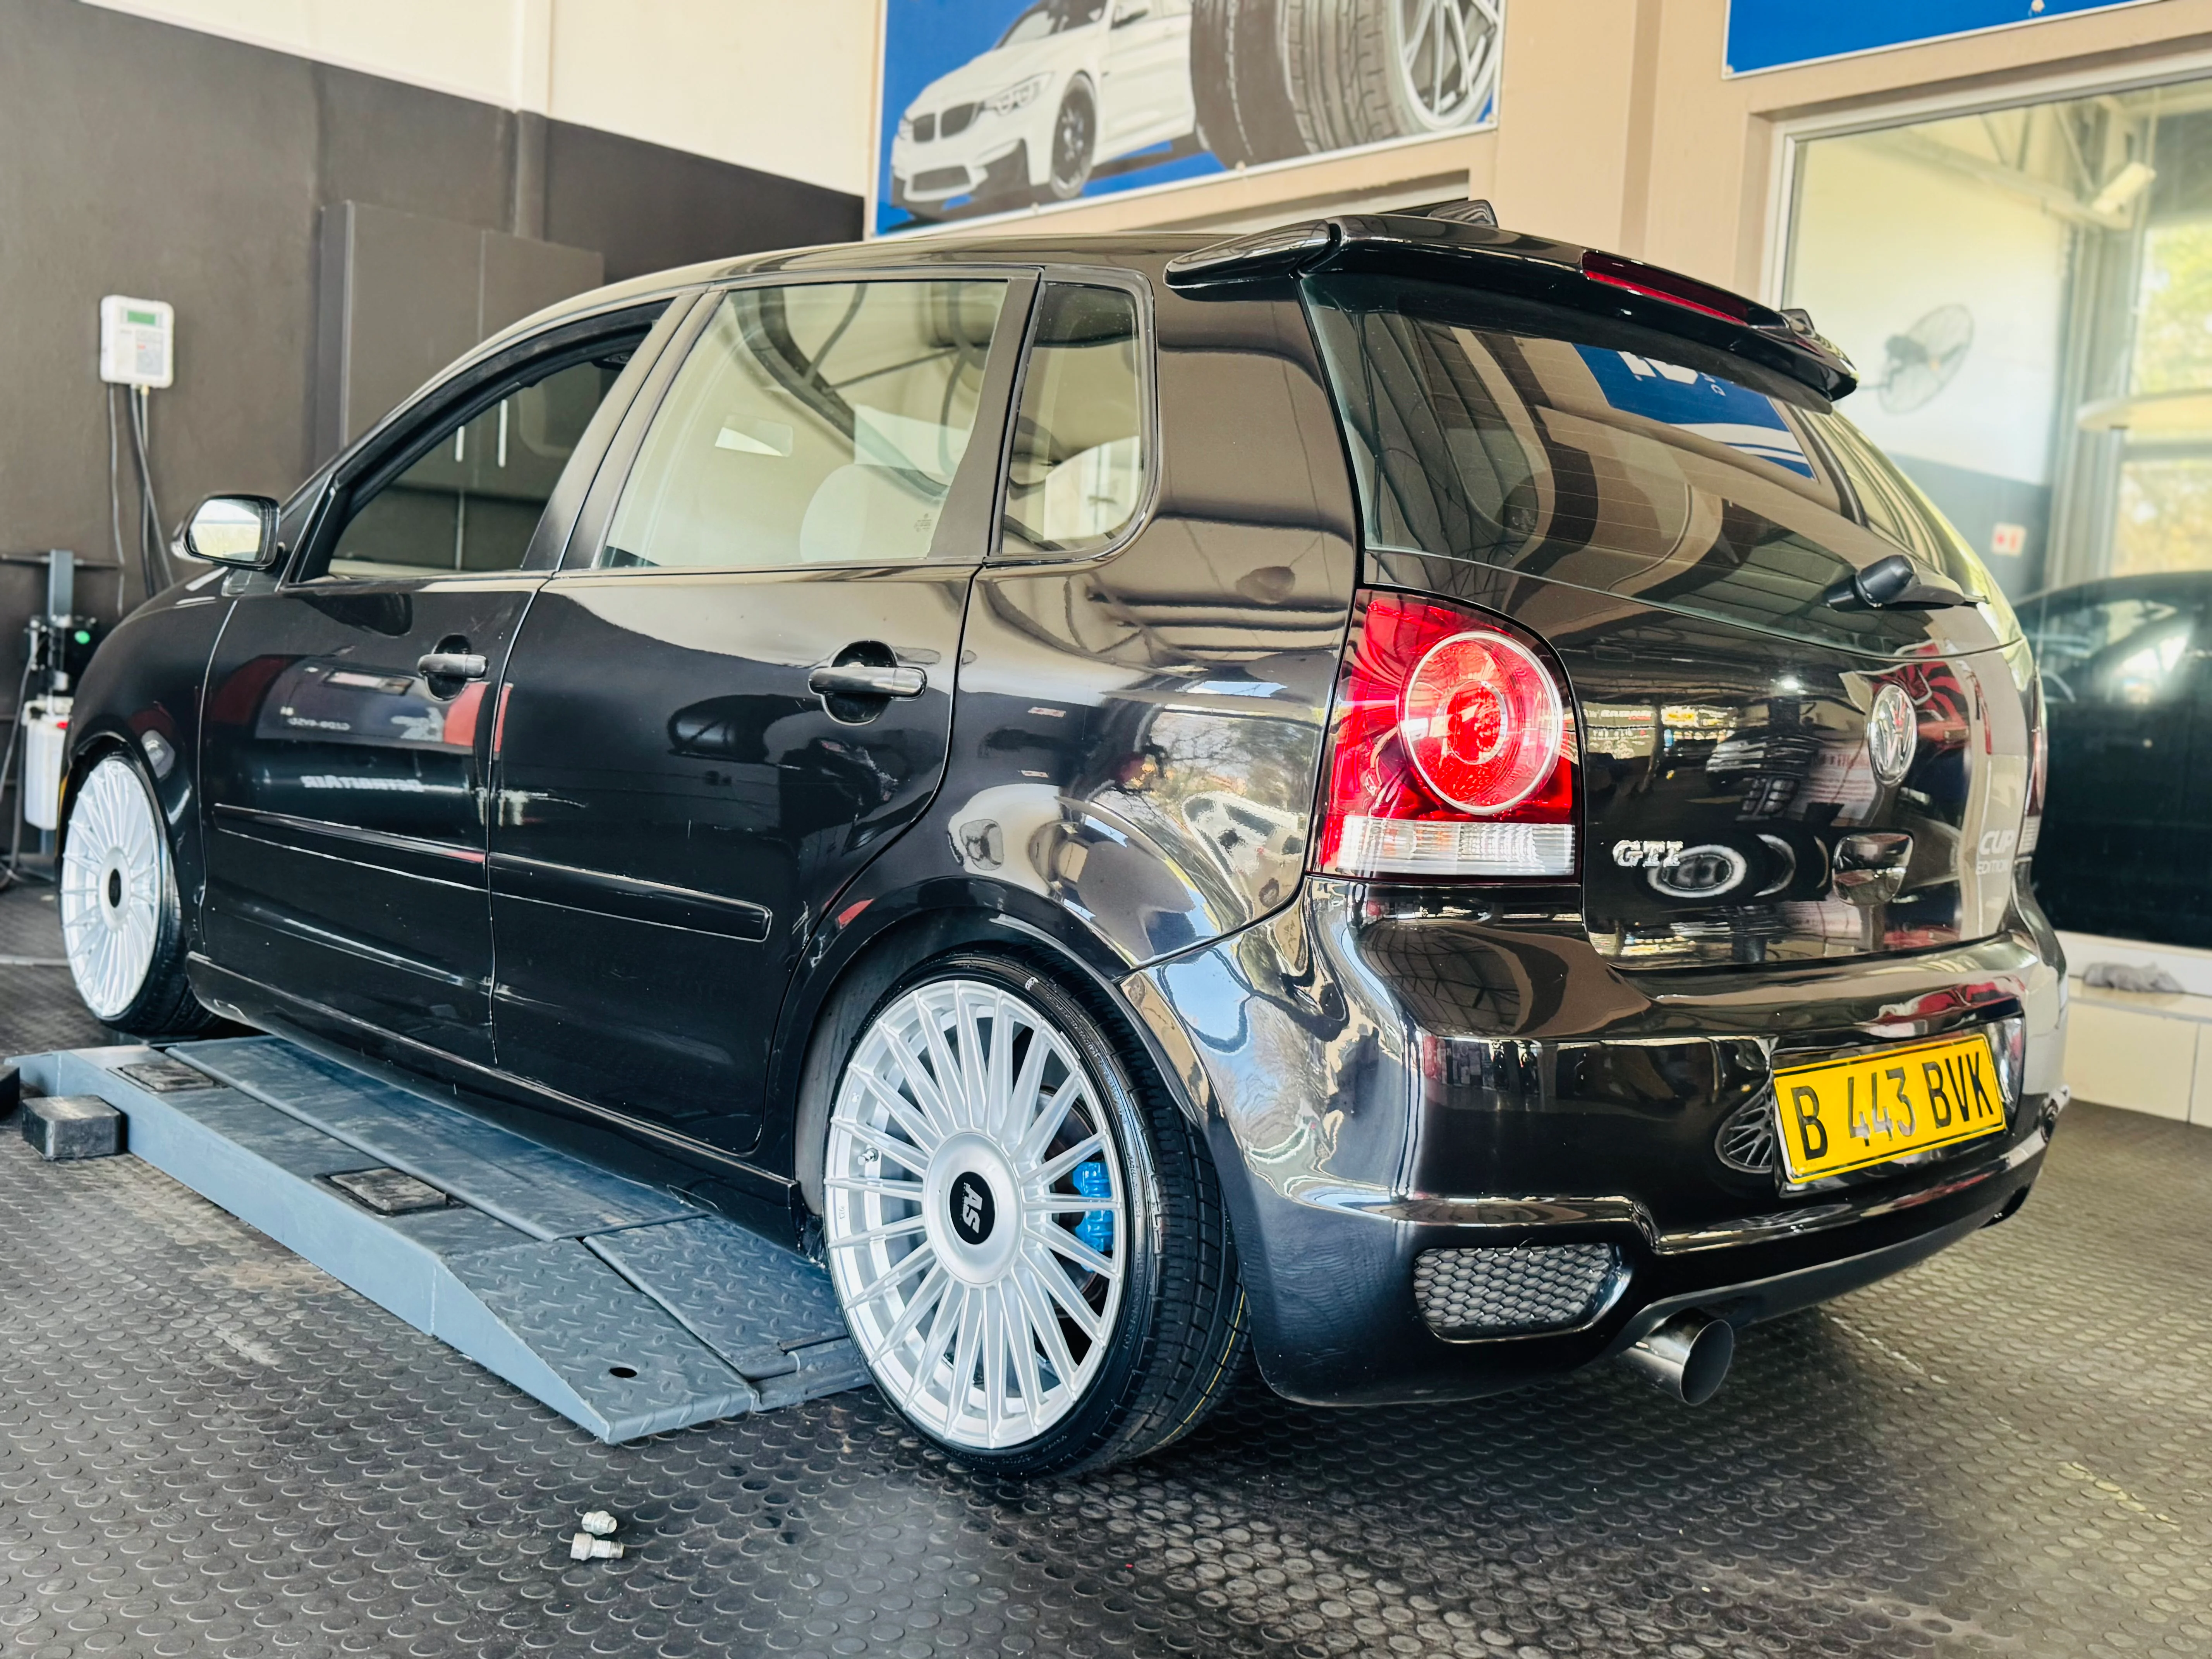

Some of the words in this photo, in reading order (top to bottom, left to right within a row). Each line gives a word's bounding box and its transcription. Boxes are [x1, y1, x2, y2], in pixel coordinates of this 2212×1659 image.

[1613, 840, 1683, 867] GTI
[1979, 830, 2016, 855] CUP
[1791, 1085, 1828, 1161] B
[1847, 1067, 1916, 1147] 443
[1922, 1051, 1994, 1129] BVK
[962, 1182, 982, 1234] AS
